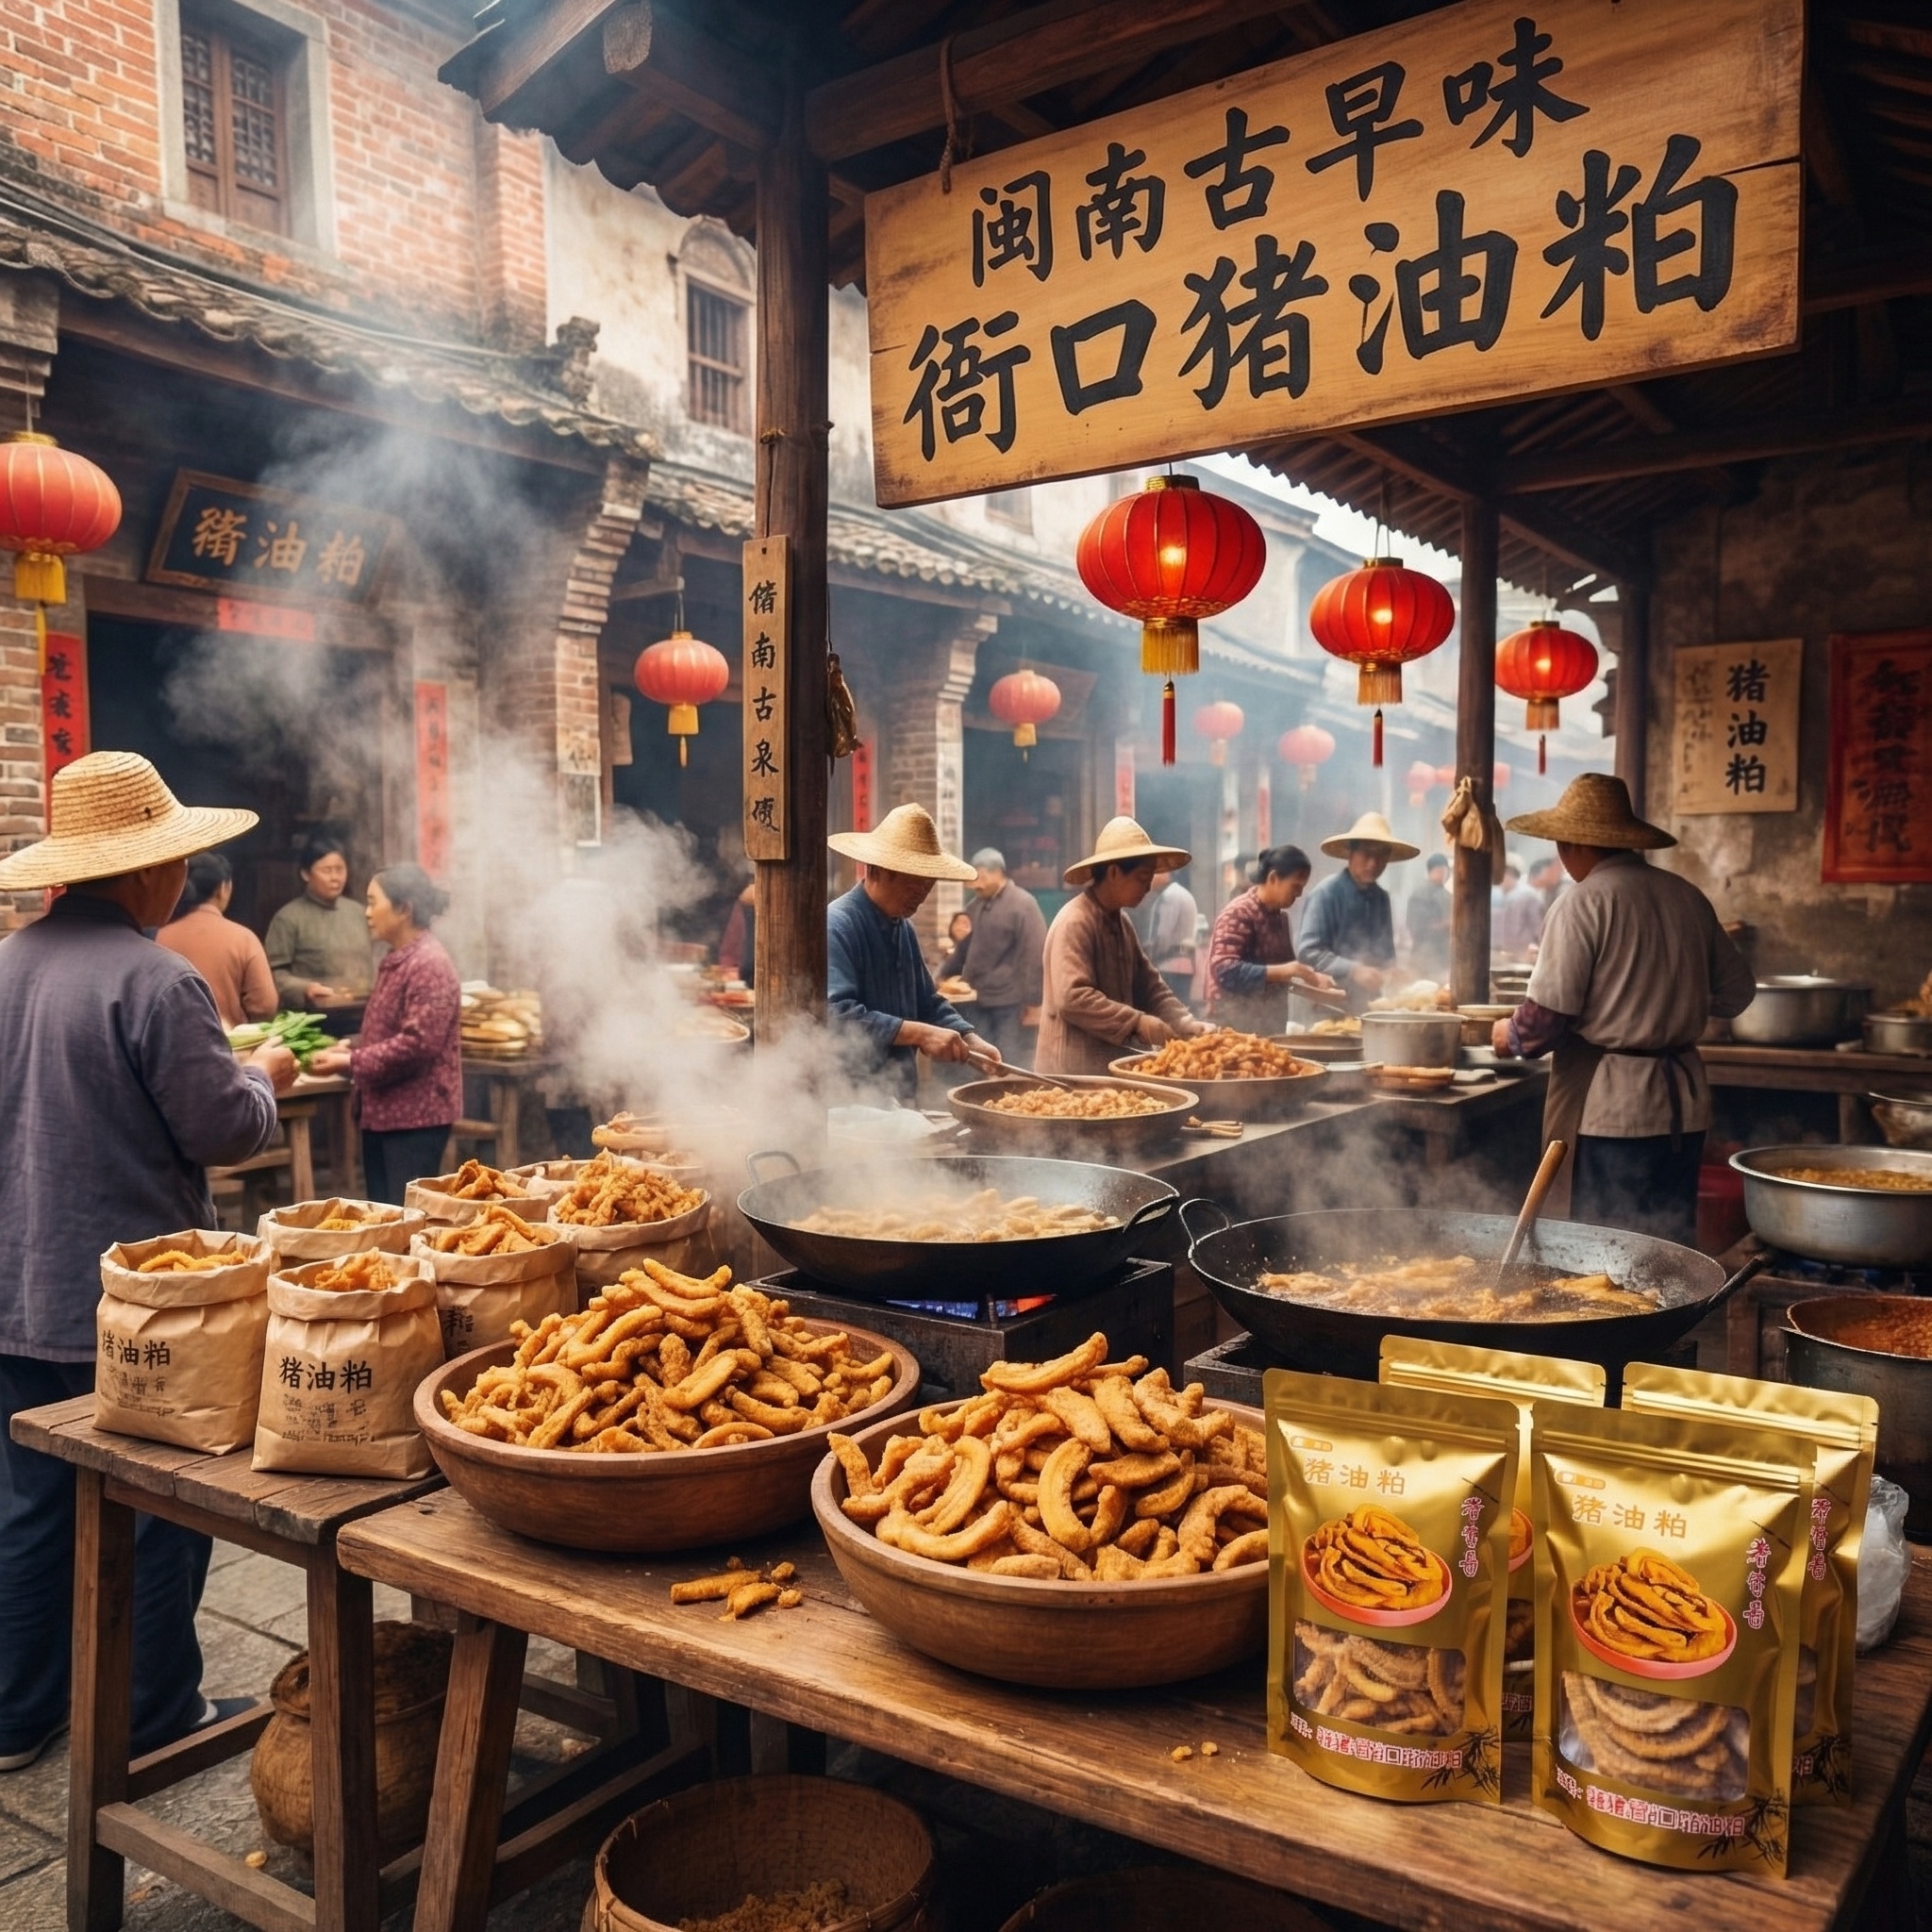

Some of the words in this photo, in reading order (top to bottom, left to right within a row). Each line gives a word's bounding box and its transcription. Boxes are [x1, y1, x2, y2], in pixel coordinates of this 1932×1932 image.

[973, 17, 1591, 287] 闽南古早味
[903, 135, 1738, 462] 衙口猪油粕
[1725, 658, 1771, 795] 猪油粕
[102, 1329, 171, 1370] 猪油粕
[278, 1356, 373, 1394] 猪油粕
[1305, 1457, 1406, 1496] 猪油粕
[1573, 1493, 1688, 1540] 猪油粕
